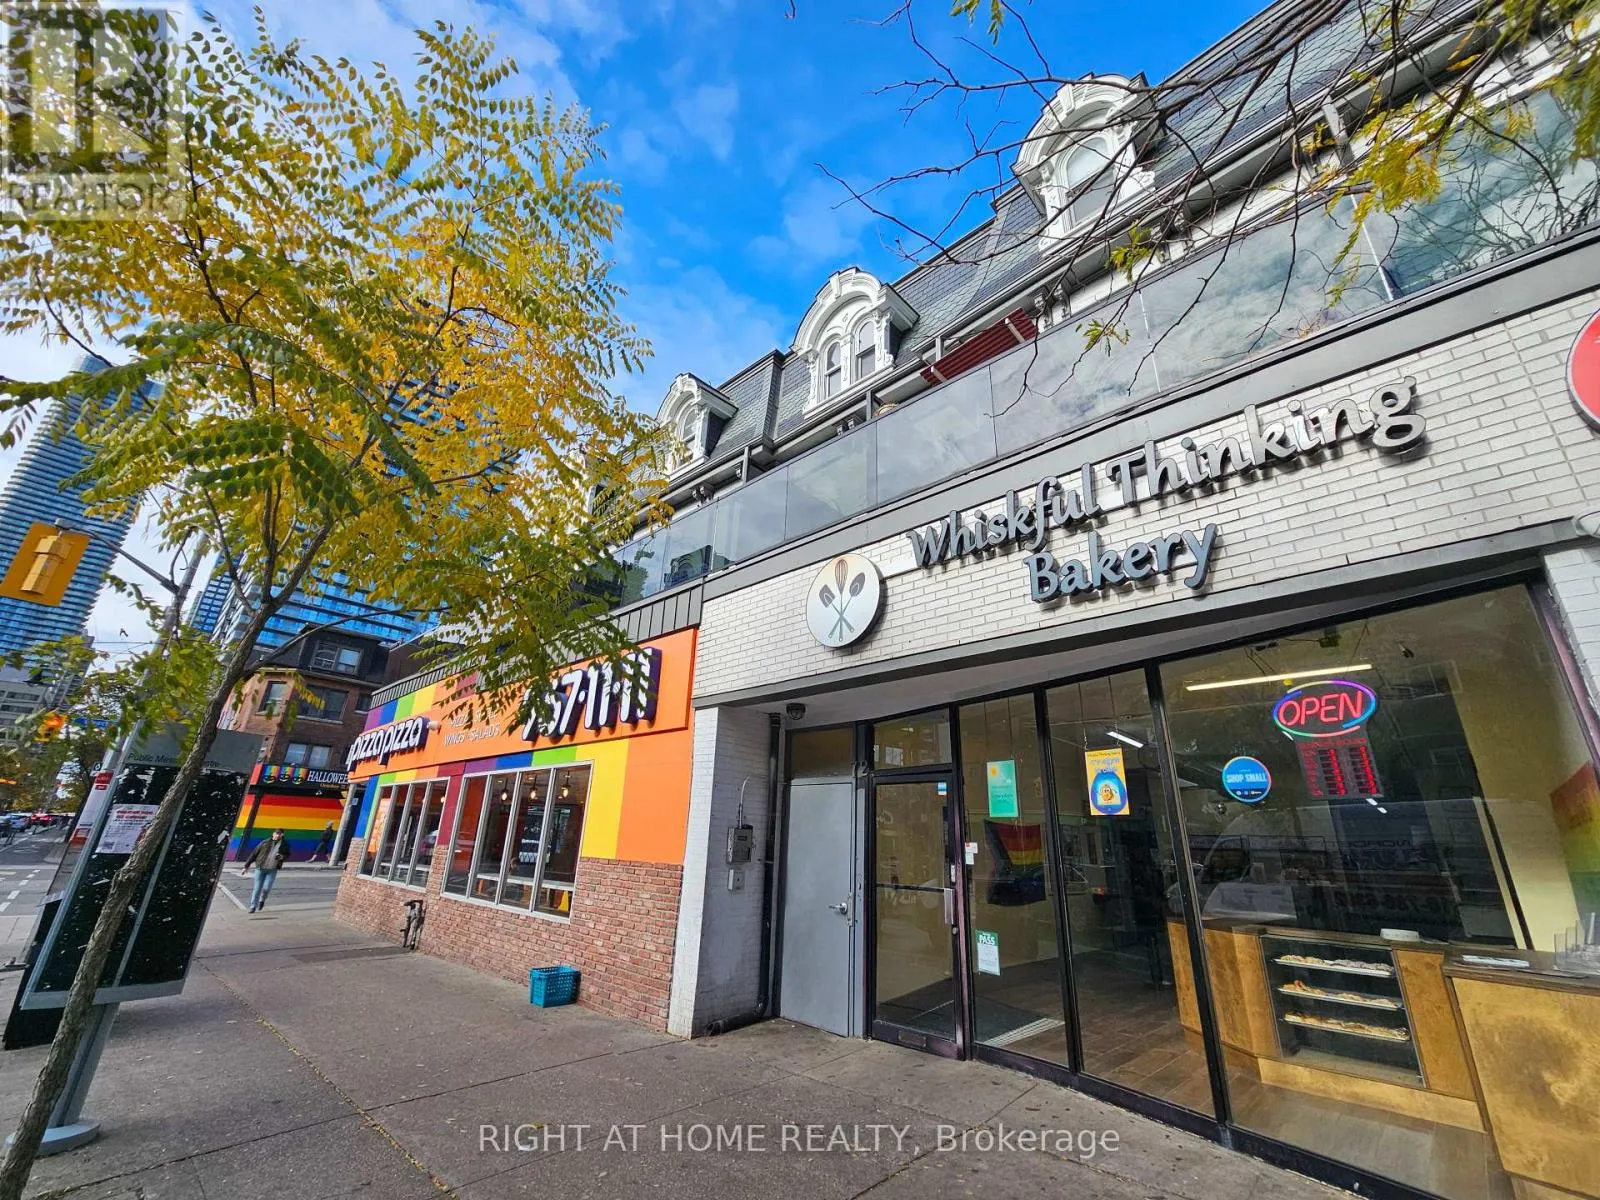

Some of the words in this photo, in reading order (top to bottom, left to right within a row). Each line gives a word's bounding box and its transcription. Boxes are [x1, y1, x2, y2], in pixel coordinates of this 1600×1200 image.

[906, 462, 1101, 568] Whiskful
[1105, 375, 1427, 504] Thinking
[1023, 522, 1218, 602] Bakery
[1278, 690, 1363, 726] OPEN
[1226, 773, 1244, 784] SHOP
[1245, 772, 1268, 783] SMALL
[978, 934, 996, 946] PASS
